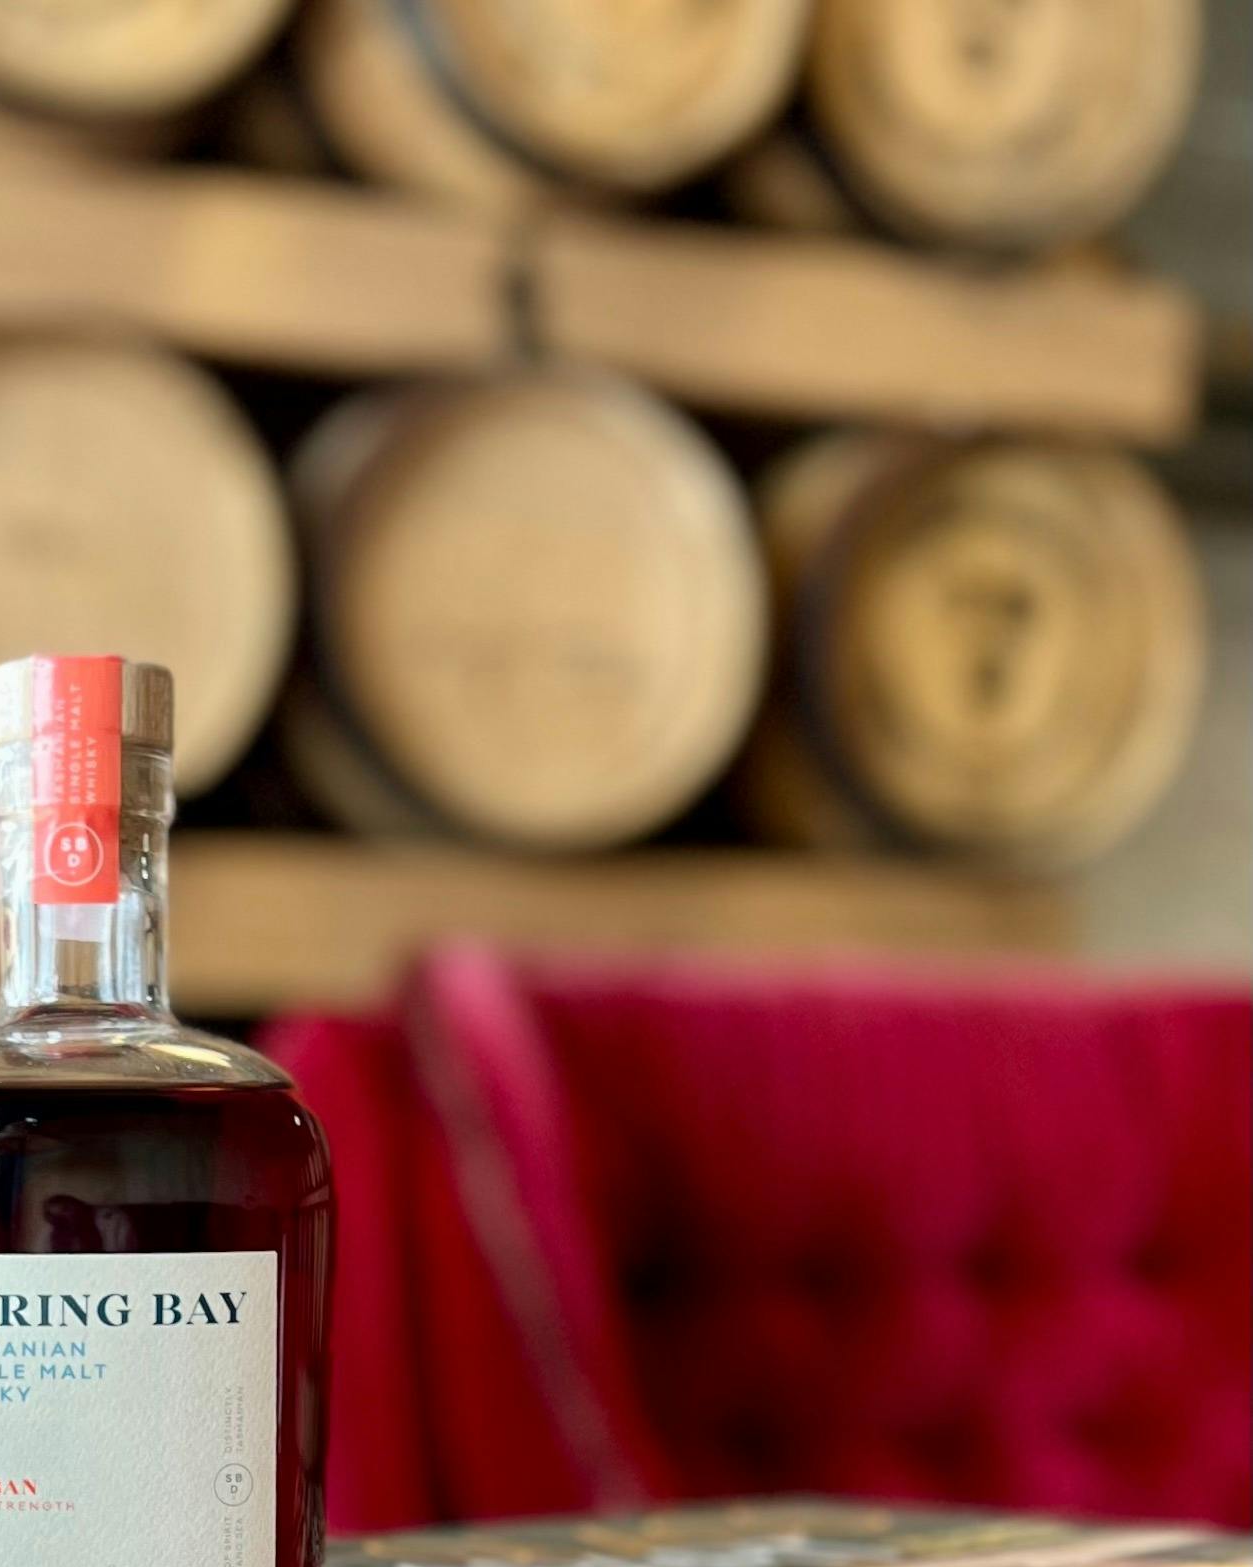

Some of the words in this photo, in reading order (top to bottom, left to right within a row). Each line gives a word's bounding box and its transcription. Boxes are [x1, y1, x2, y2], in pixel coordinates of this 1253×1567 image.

[69, 683, 82, 732] MALT
[69, 736, 82, 806] SINGLE
[85, 735, 98, 805] WHISKY
[151, 1291, 247, 1326] BAY
[39, 1363, 107, 1380] MALT
